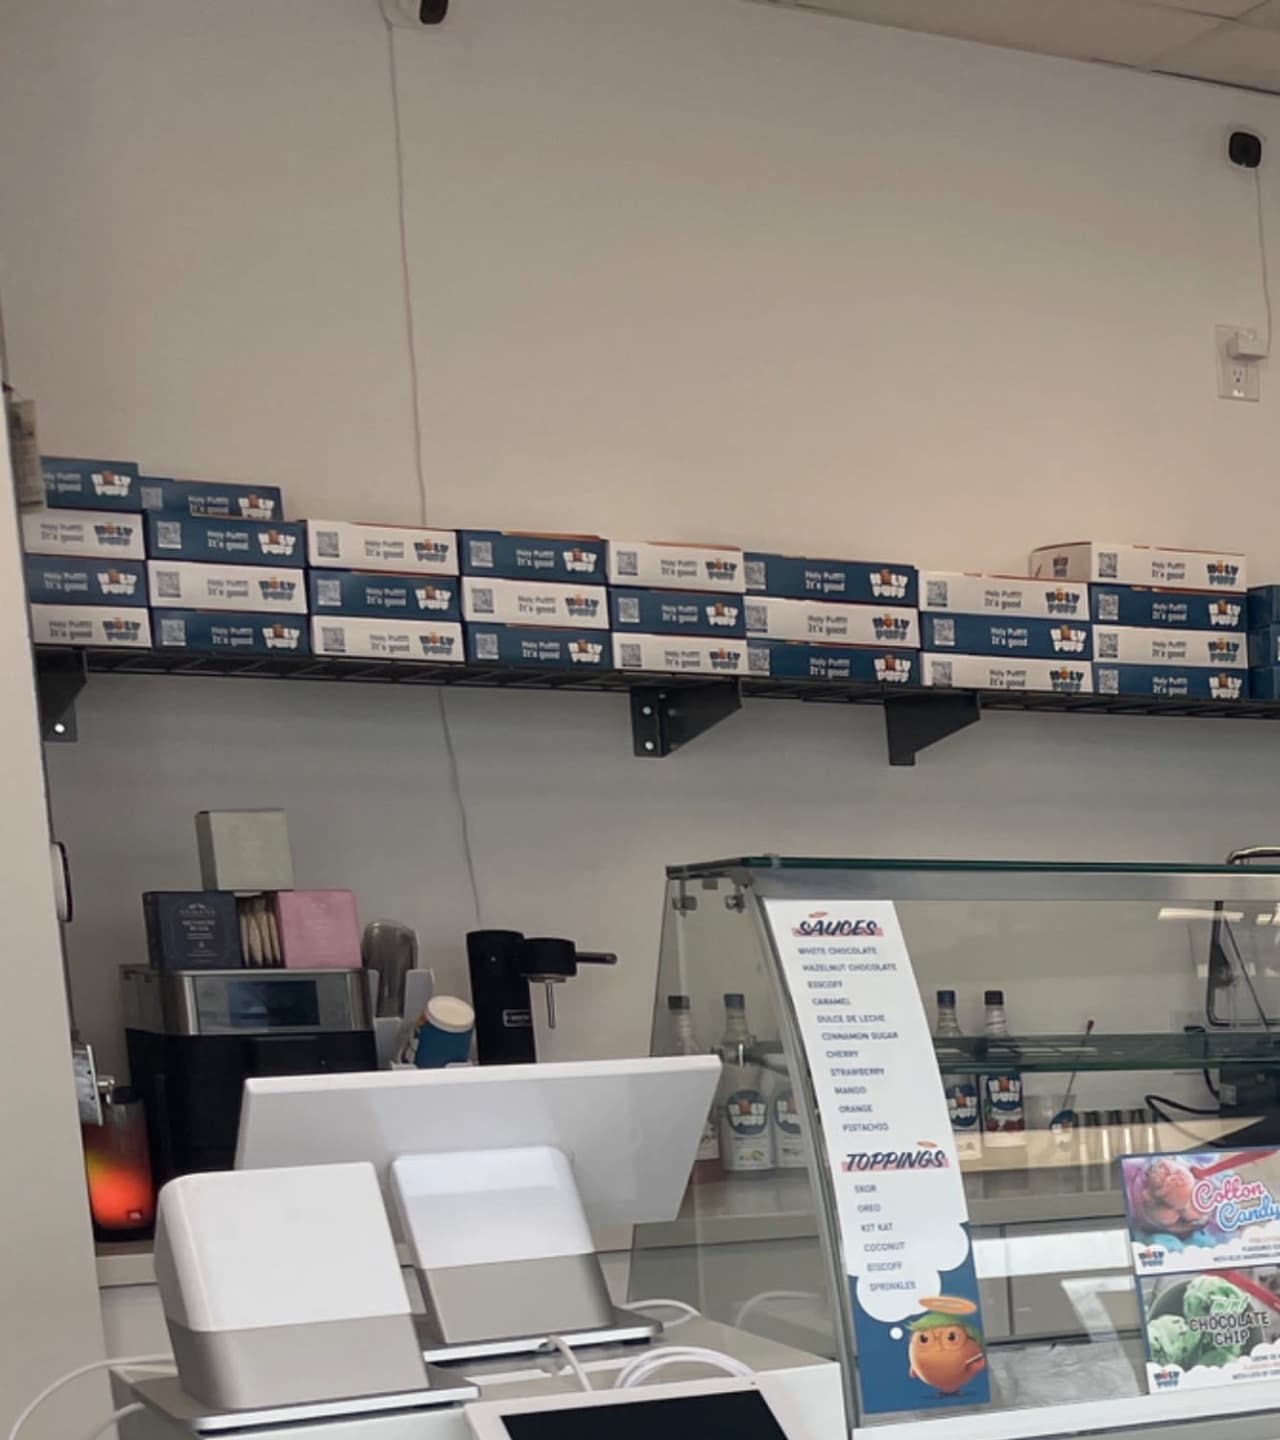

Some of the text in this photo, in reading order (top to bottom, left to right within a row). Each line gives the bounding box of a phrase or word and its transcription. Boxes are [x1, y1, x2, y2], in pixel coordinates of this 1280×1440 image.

[798, 919, 877, 936] SAUCES
[798, 947, 877, 955] WHITE CHOCOLATE
[803, 963, 897, 972] HAZELNUT CHOCOLATE
[812, 997, 851, 1006] CARAMEL
[817, 1014, 885, 1023] DULCE DE LECHE
[821, 1031, 898, 1041] CINNAMON SUGAR
[826, 1050, 858, 1058] CHERRY
[830, 1068, 884, 1077] STRAWBERRY
[834, 1086, 866, 1095] MANGO
[839, 1104, 873, 1113] ORANGE
[842, 1123, 888, 1132] PISTACHIO
[846, 1150, 945, 1171] TOPPINGS
[854, 1184, 877, 1193] SKOR
[1193, 1177, 1265, 1211] Cotton
[857, 1204, 881, 1213] OREO
[861, 1222, 893, 1232] KIT KAT
[864, 1241, 905, 1252] COCONUT
[867, 1261, 902, 1272] BISCOFF
[869, 1280, 917, 1292] SPRINKLES
[1190, 1312, 1270, 1332] CHOCOLATE
[1213, 1329, 1250, 1346] CHIP
